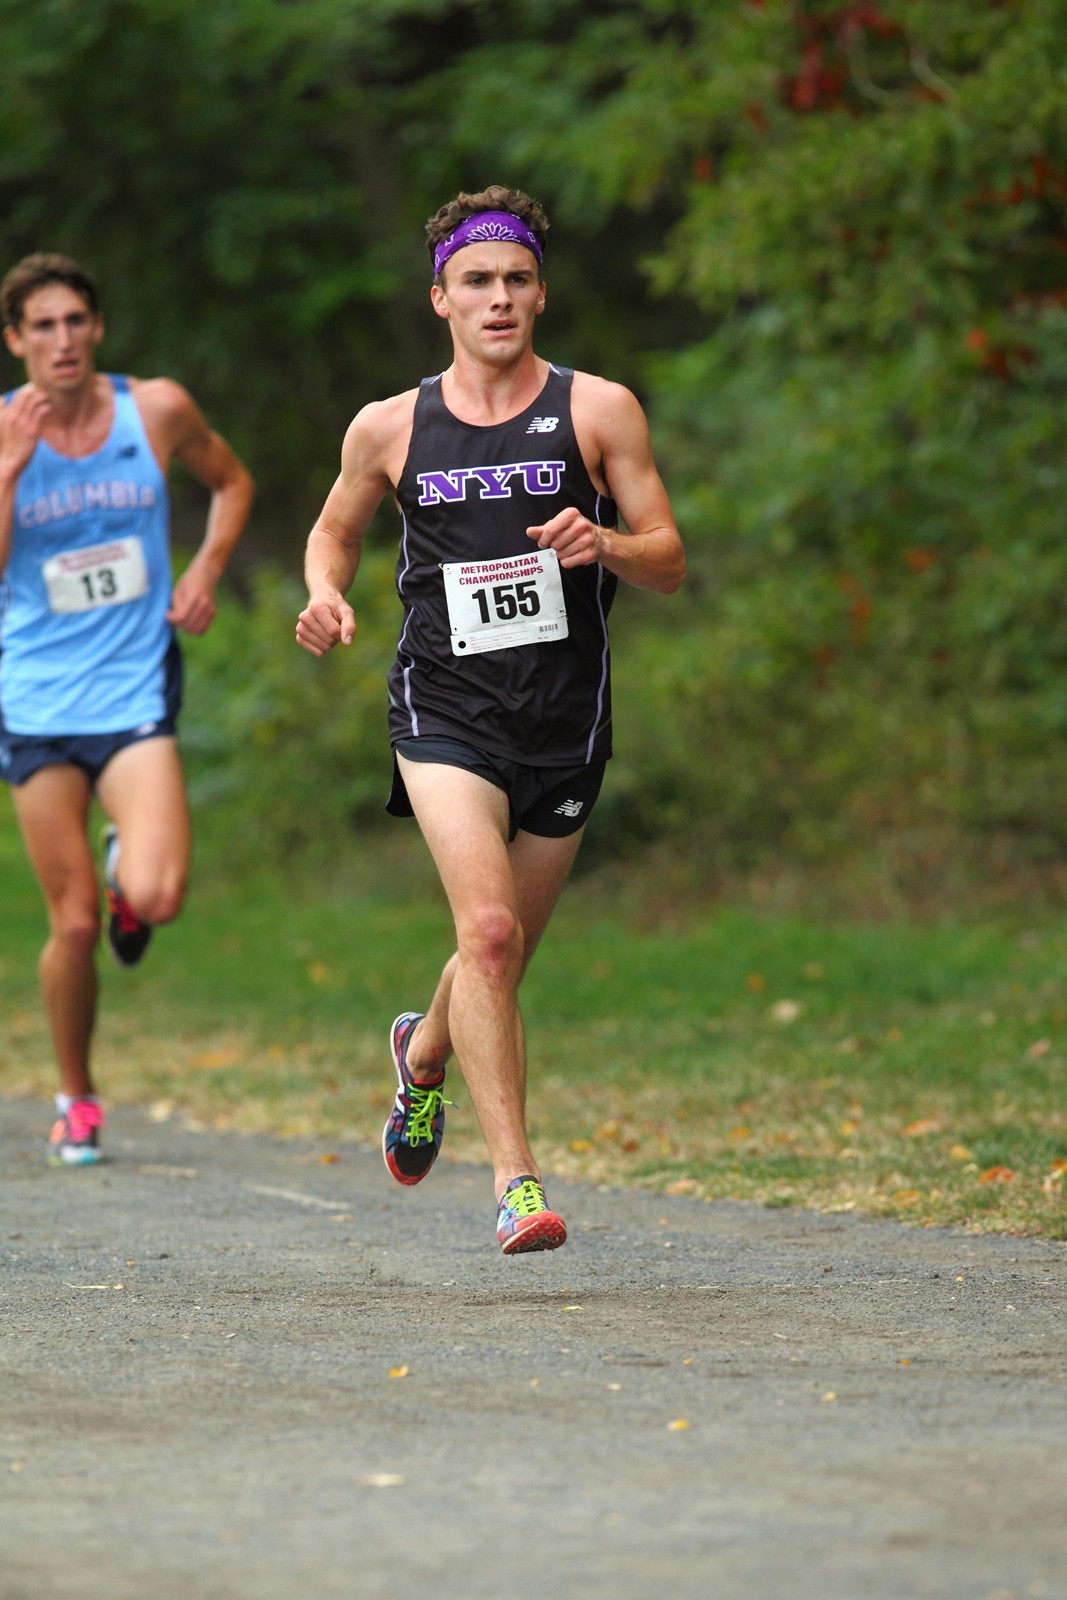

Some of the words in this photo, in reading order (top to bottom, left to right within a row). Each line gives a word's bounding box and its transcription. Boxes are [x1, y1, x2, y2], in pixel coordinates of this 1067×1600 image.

[416, 460, 566, 506] NYU
[458, 566, 544, 585] CHAMPIONSHIPS
[460, 556, 539, 574] METROPOLITAN
[80, 568, 117, 602] 13
[471, 580, 541, 624] 155
